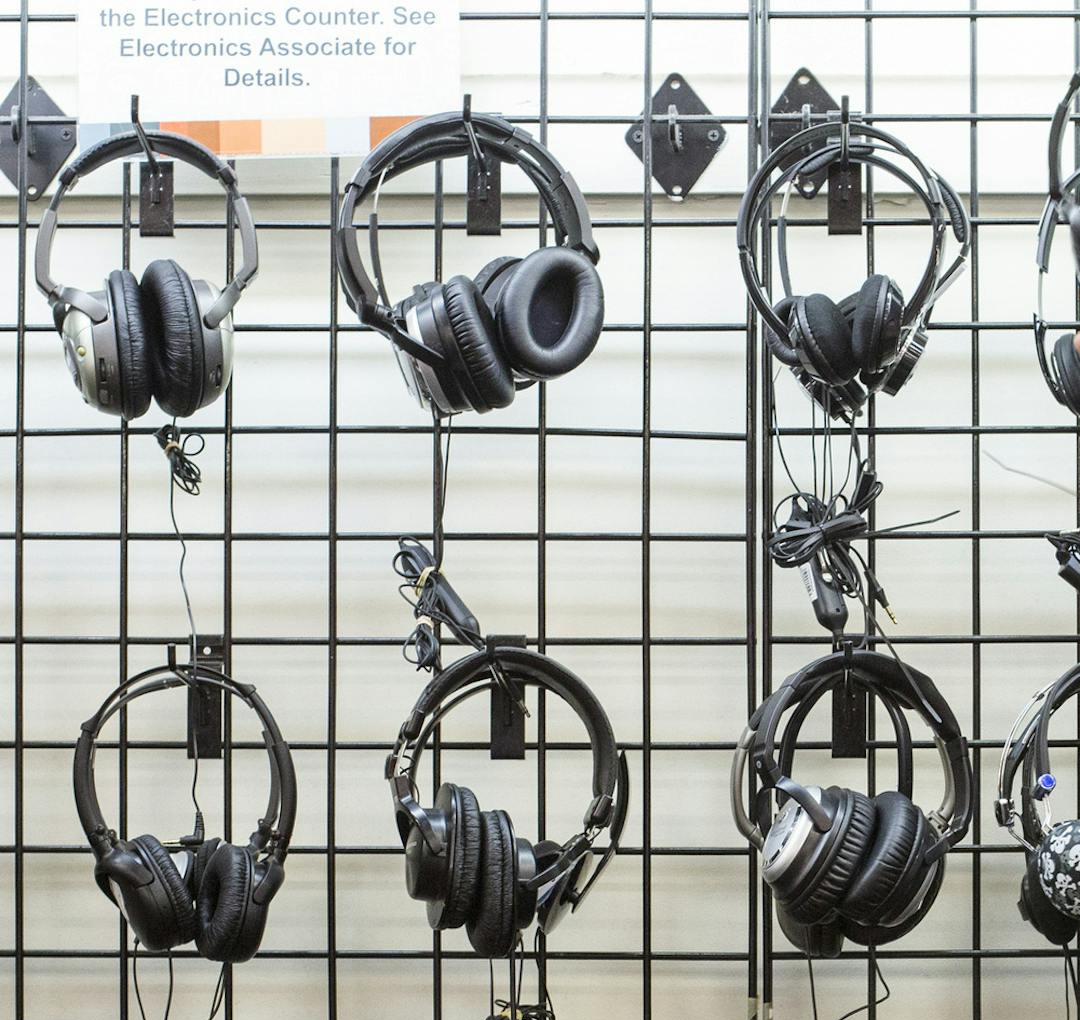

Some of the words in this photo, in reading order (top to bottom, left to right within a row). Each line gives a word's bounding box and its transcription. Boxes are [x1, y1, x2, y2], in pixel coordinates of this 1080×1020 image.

[100, 9, 136, 27] the
[144, 7, 276, 27] Electronics
[285, 7, 384, 26] Counter.
[393, 7, 436, 26] See
[119, 38, 252, 58] Electronics
[259, 37, 376, 57] Associate
[384, 37, 417, 56] for
[224, 68, 311, 88] Details.
